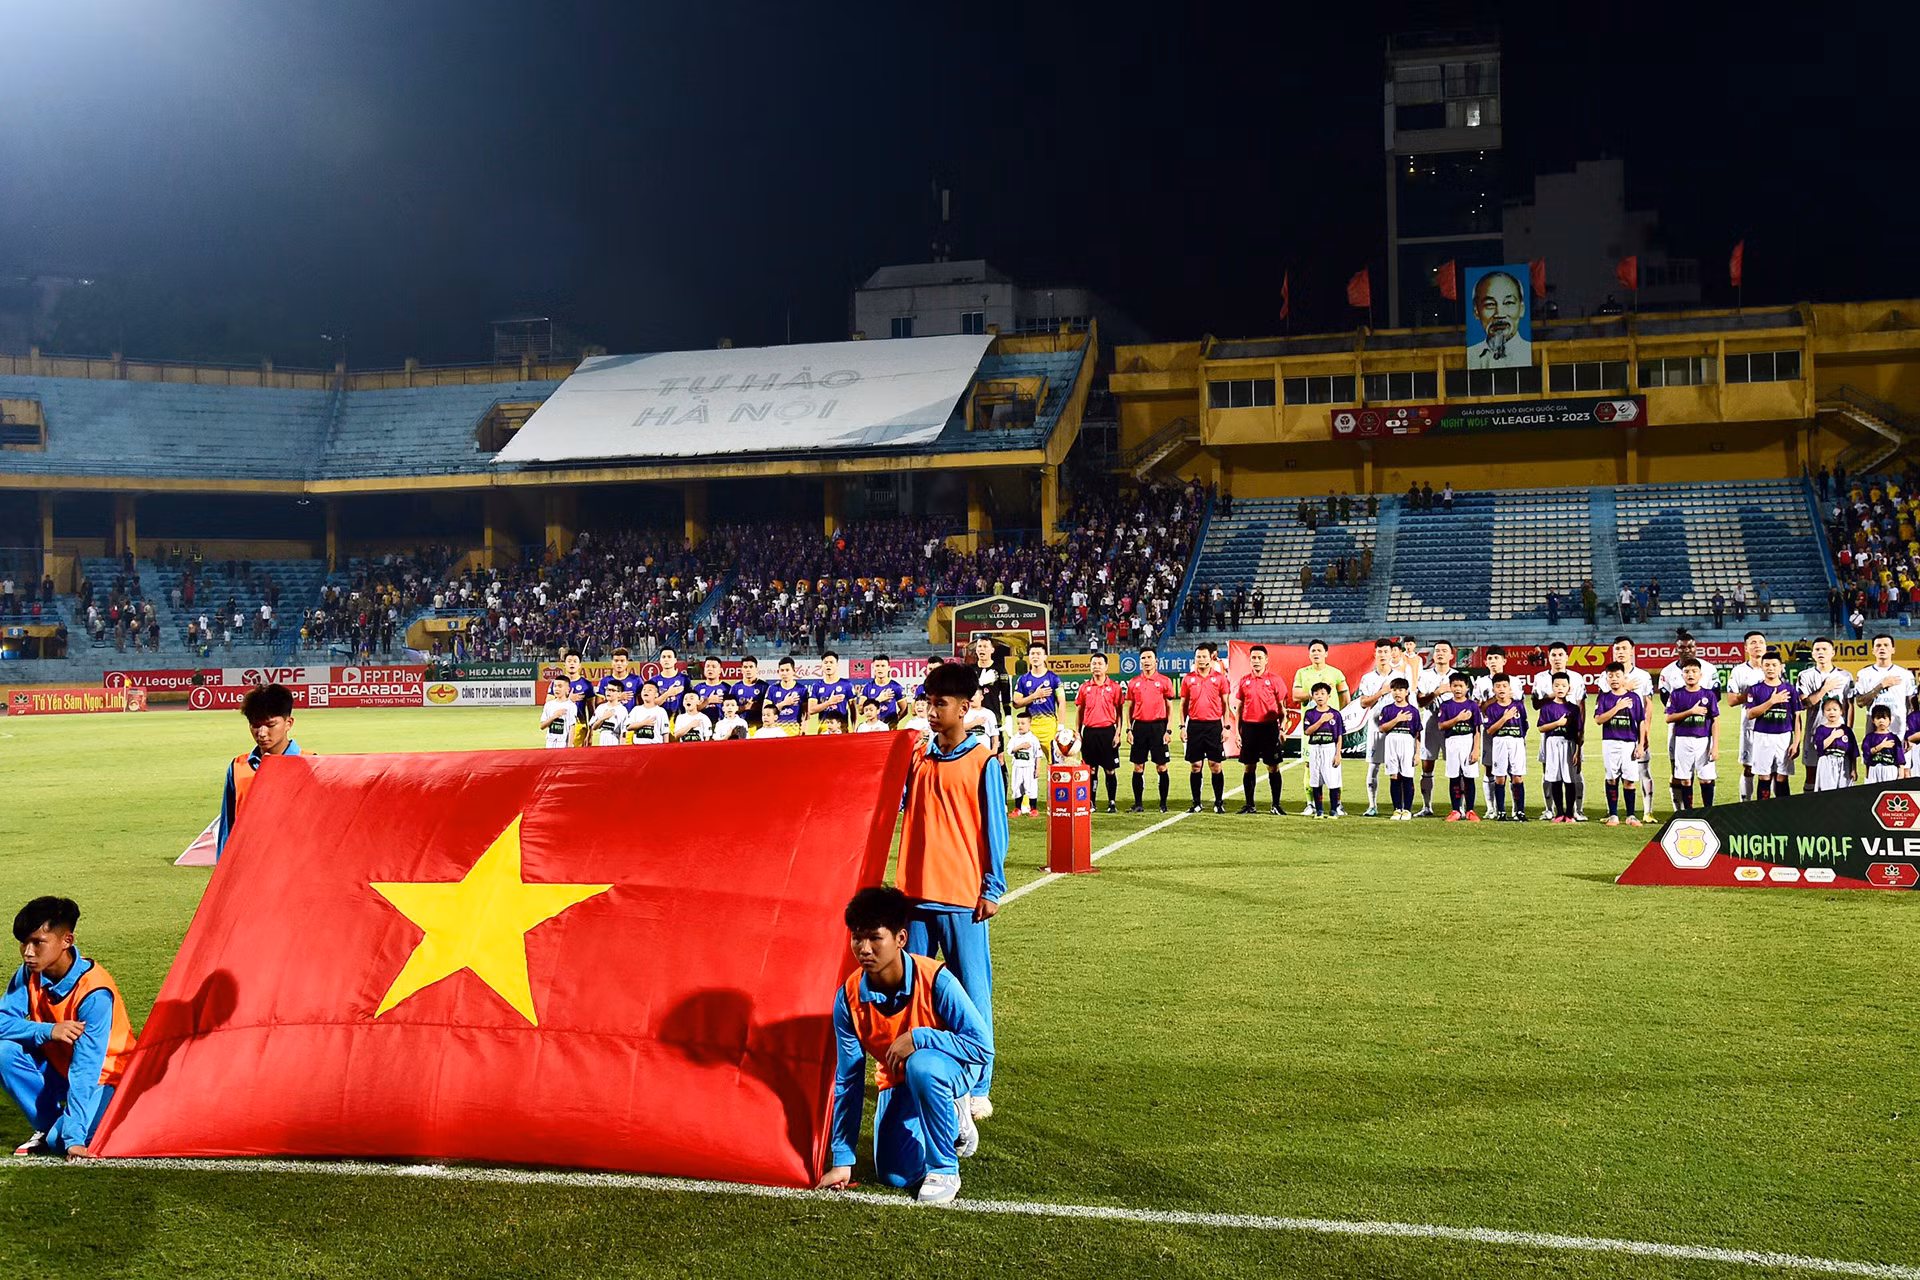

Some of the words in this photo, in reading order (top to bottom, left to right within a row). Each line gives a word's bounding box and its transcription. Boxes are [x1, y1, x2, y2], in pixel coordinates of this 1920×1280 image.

[1440, 418, 1464, 428] NIGHT
[1467, 418, 1488, 428] WOLF
[1492, 414, 1546, 426] V.LEAGUE
[1548, 414, 1554, 422] 1
[1562, 412, 1590, 422] 2023
[1566, 646, 1610, 666] K5
[1637, 646, 1742, 658] JOGABOLA
[1048, 660, 1071, 669] T&T
[264, 668, 305, 682] VPF
[364, 670, 390, 682] FPT
[393, 670, 422, 682] Play
[491, 666, 505, 676] ĂN
[721, 668, 741, 677] VPF
[133, 676, 192, 687] V.League
[203, 676, 220, 685] PF
[292, 691, 306, 701] PF
[329, 685, 422, 696] JOGARBOLA
[462, 685, 475, 699] CÔNG
[476, 688, 481, 698] TY
[482, 688, 488, 698] CP
[105, 692, 125, 709] Linh
[1729, 833, 1788, 863] NIGHT
[1796, 835, 1853, 865] WOLF
